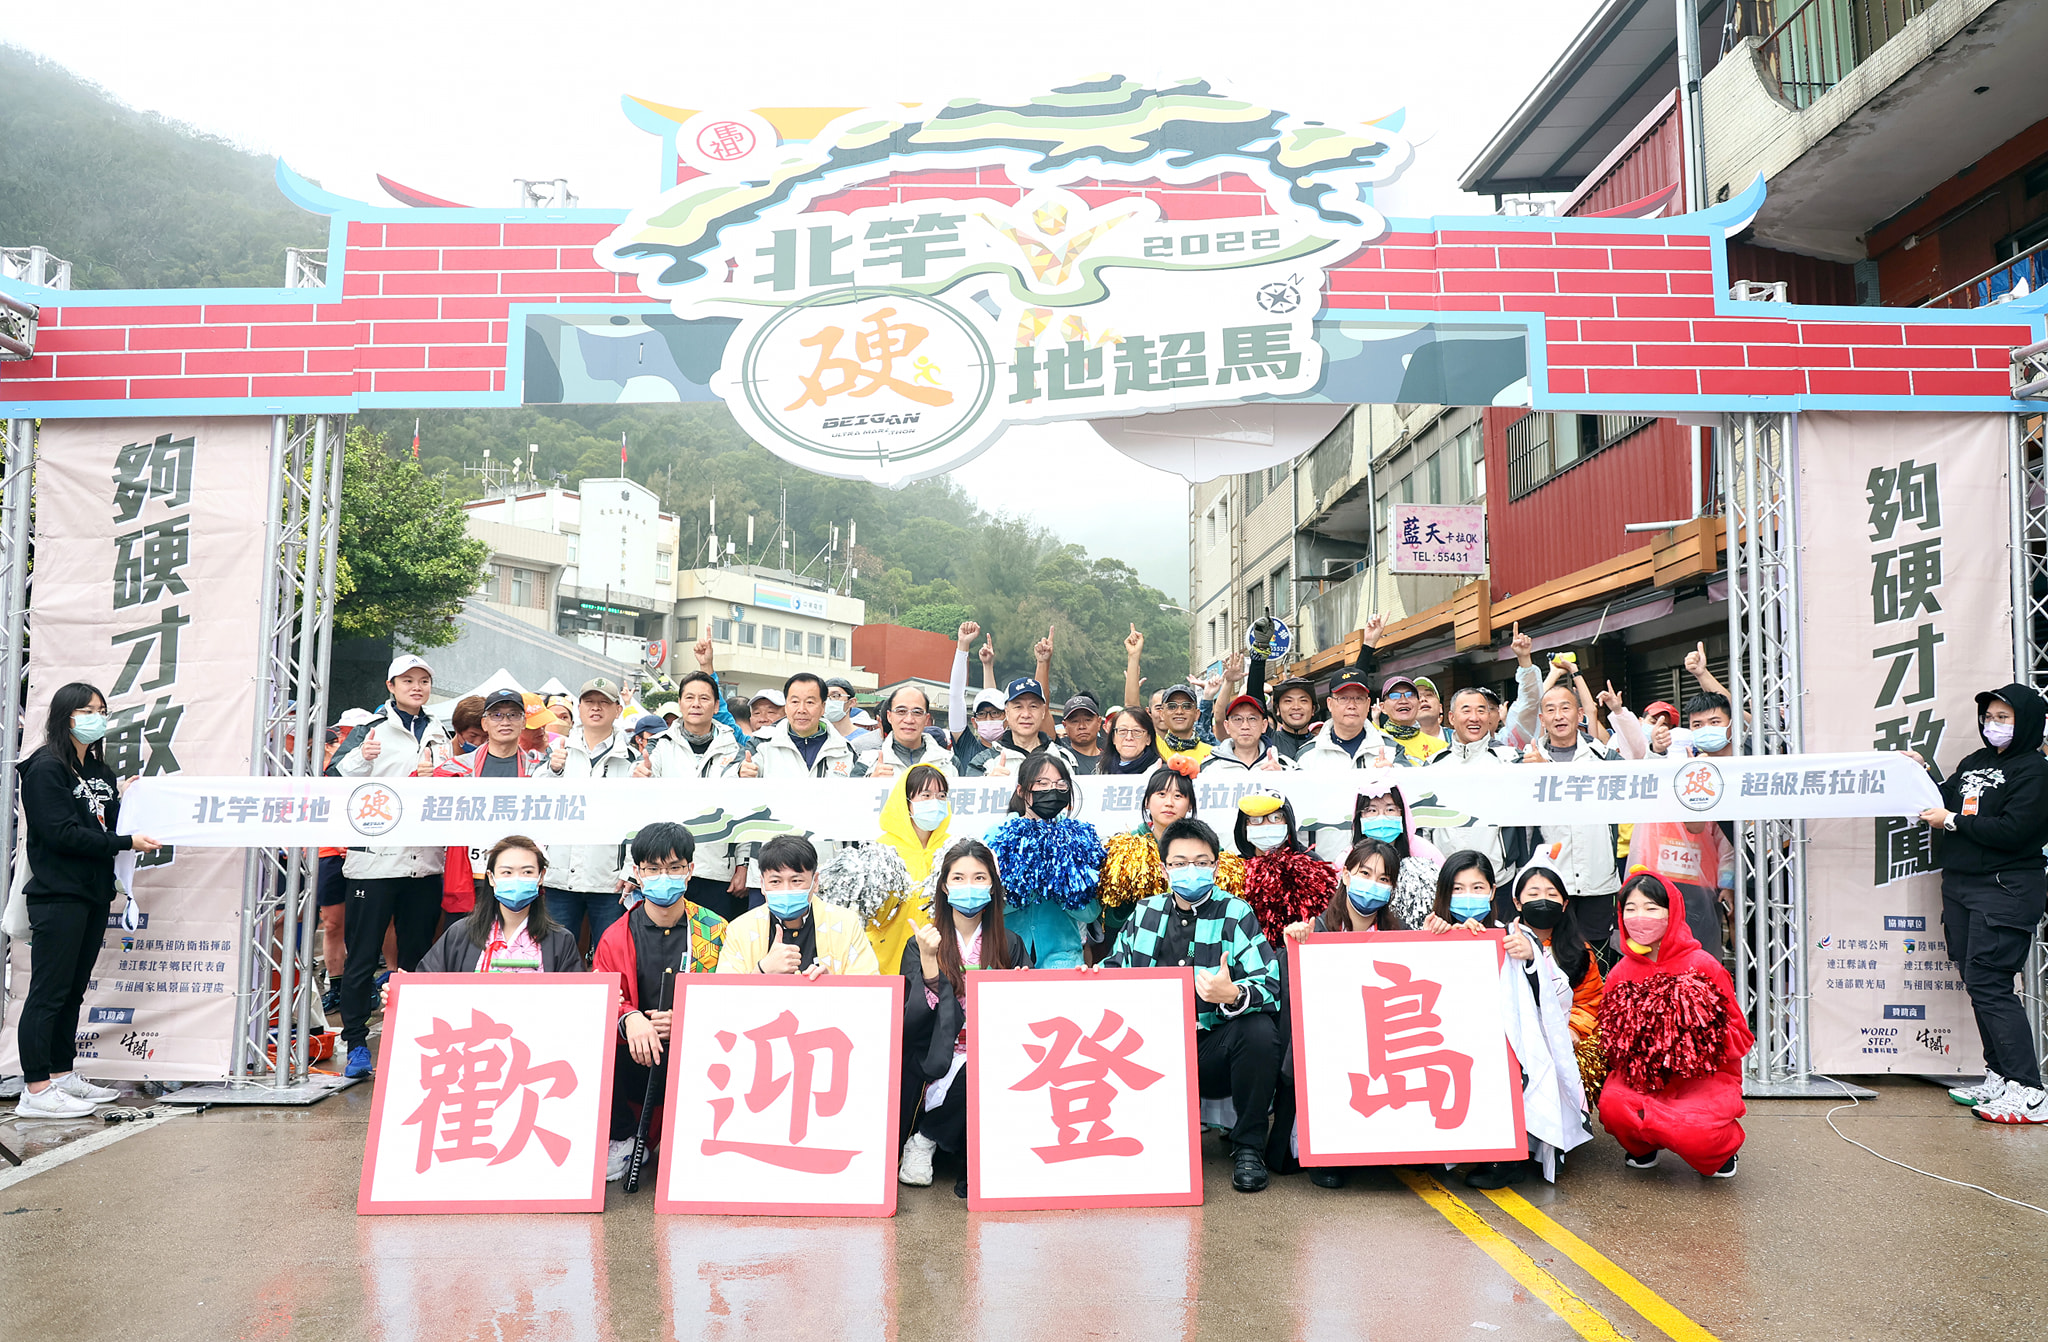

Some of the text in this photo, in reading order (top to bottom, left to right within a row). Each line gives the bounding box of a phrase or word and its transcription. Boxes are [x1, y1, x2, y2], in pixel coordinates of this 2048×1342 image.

[709, 123, 744, 159] 馬祖
[753, 213, 966, 292] 北竿
[1143, 228, 1281, 257] 2022
[784, 307, 955, 411] 硬
[1008, 322, 1302, 404] 地超馬
[822, 412, 921, 429] BEIGAN
[1401, 516, 1478, 545] 藍天 卡拉OK
[104, 432, 197, 869] 夠硬才敢
[1533, 773, 1659, 802] 北竿硬地
[1682, 767, 1716, 796] 硬
[1740, 769, 1886, 797] 超級馬拉松
[192, 796, 330, 823] 北竿硬地
[355, 790, 393, 820] 硬
[420, 794, 587, 822] 超級馬拉松
[135, 939, 231, 951] 陸軍馬祖防衛指揮部
[1836, 939, 1889, 950] 北竿鄉公所
[118, 959, 226, 973] 連江縣北竿鄉民代表會
[1826, 959, 1878, 970] 連江縣議會
[114, 981, 225, 994] 馬祖國家風景區管理處
[1826, 979, 1886, 990] 交通部觀光局
[1348, 959, 1475, 1130] 島
[1860, 1027, 1898, 1036] WORLD
[402, 1007, 579, 1175] 歡
[700, 1008, 865, 1175] 迎
[1007, 1008, 1166, 1164] 登
